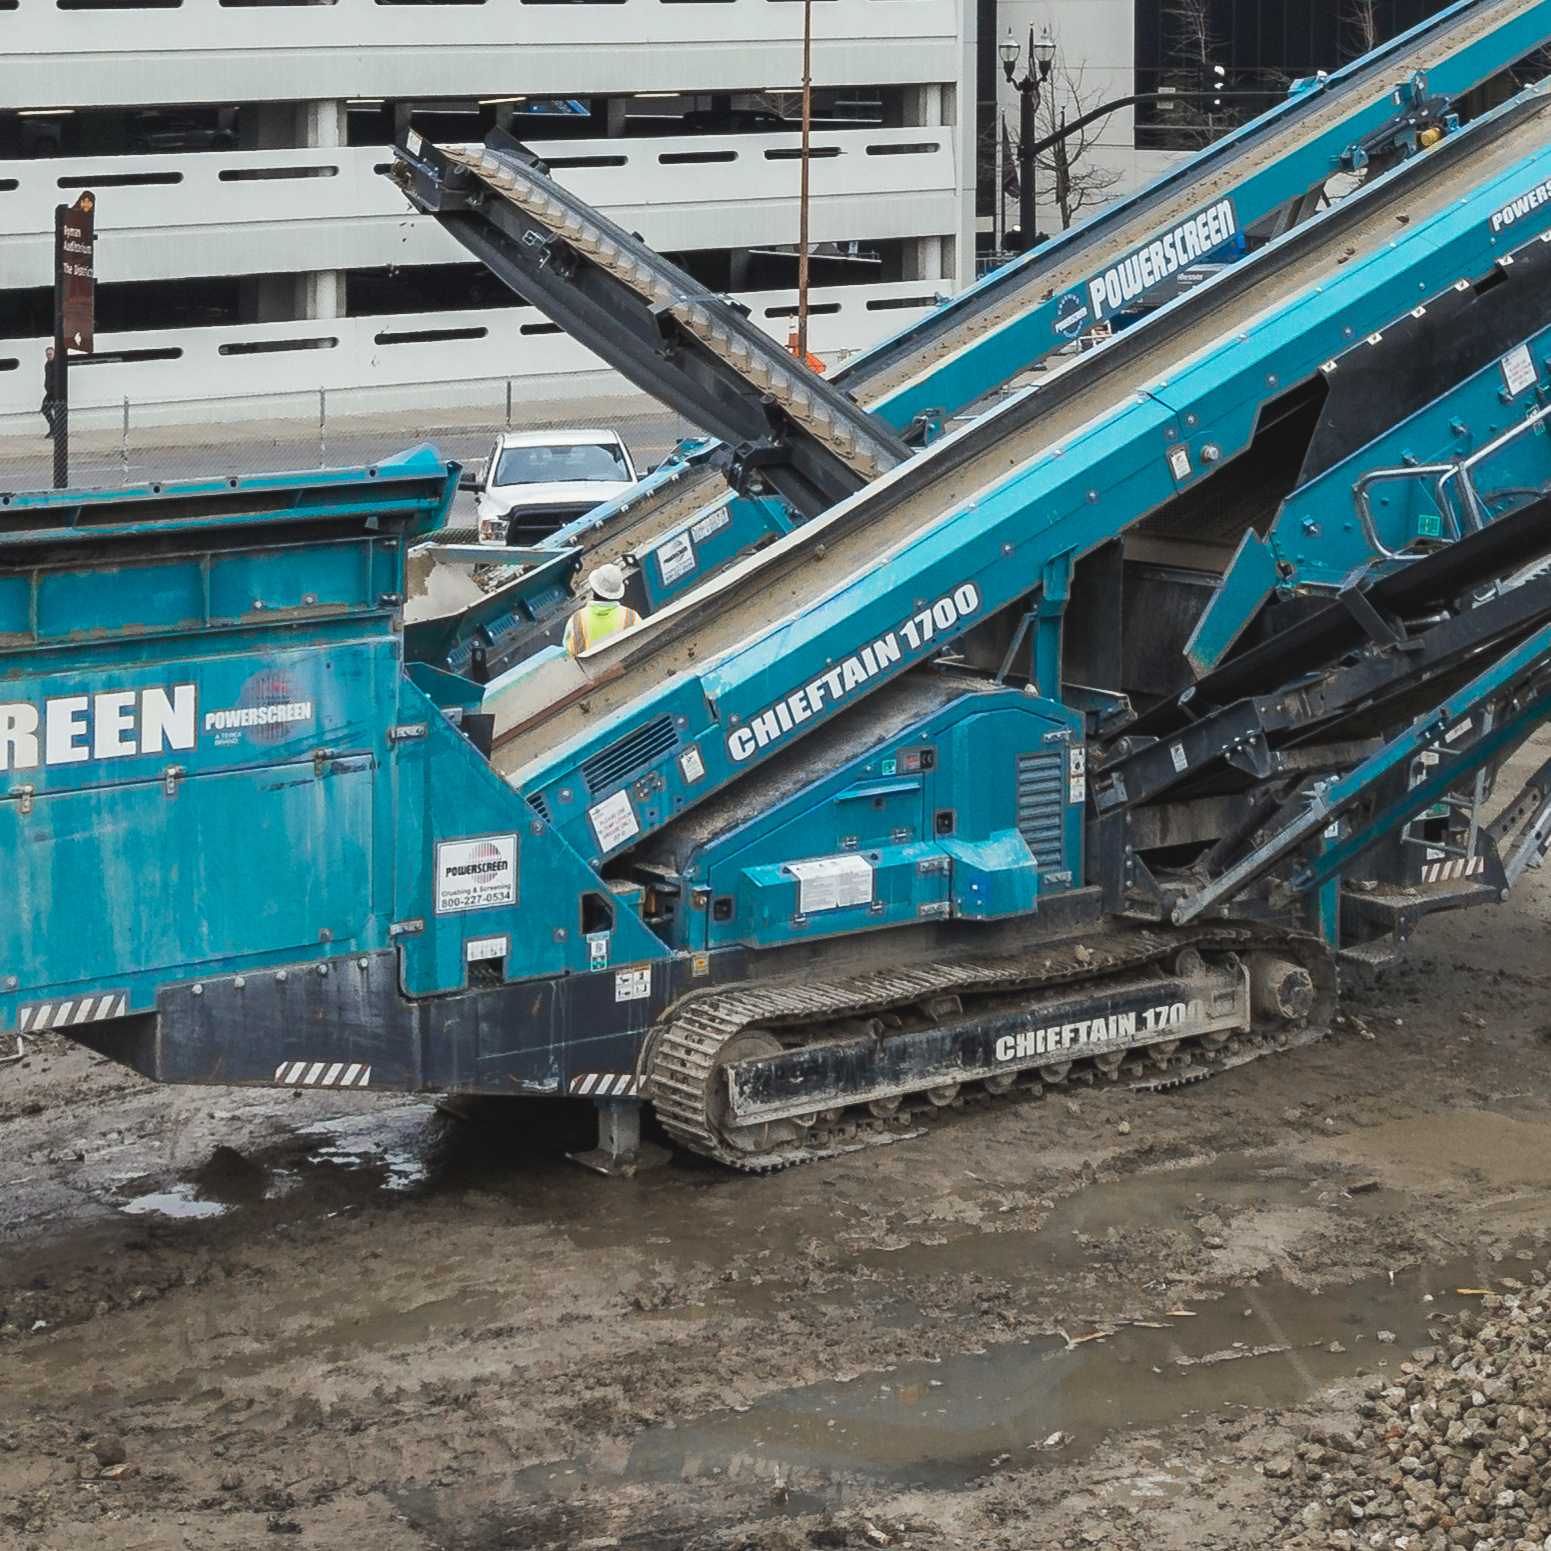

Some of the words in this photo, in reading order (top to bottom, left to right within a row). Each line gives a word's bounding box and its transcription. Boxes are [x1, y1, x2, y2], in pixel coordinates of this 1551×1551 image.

[1089, 199, 1235, 320] POWERSCREEN
[727, 632, 902, 762] CHIEFTAIN
[900, 583, 979, 650] 1700
[205, 701, 311, 731] POWERSCREEN
[445, 860, 509, 878] POWERSCREEN
[441, 888, 471, 897] Crushing
[441, 891, 511, 908] 800-227-0534
[995, 1011, 1136, 1061] CHIEFTAIN
